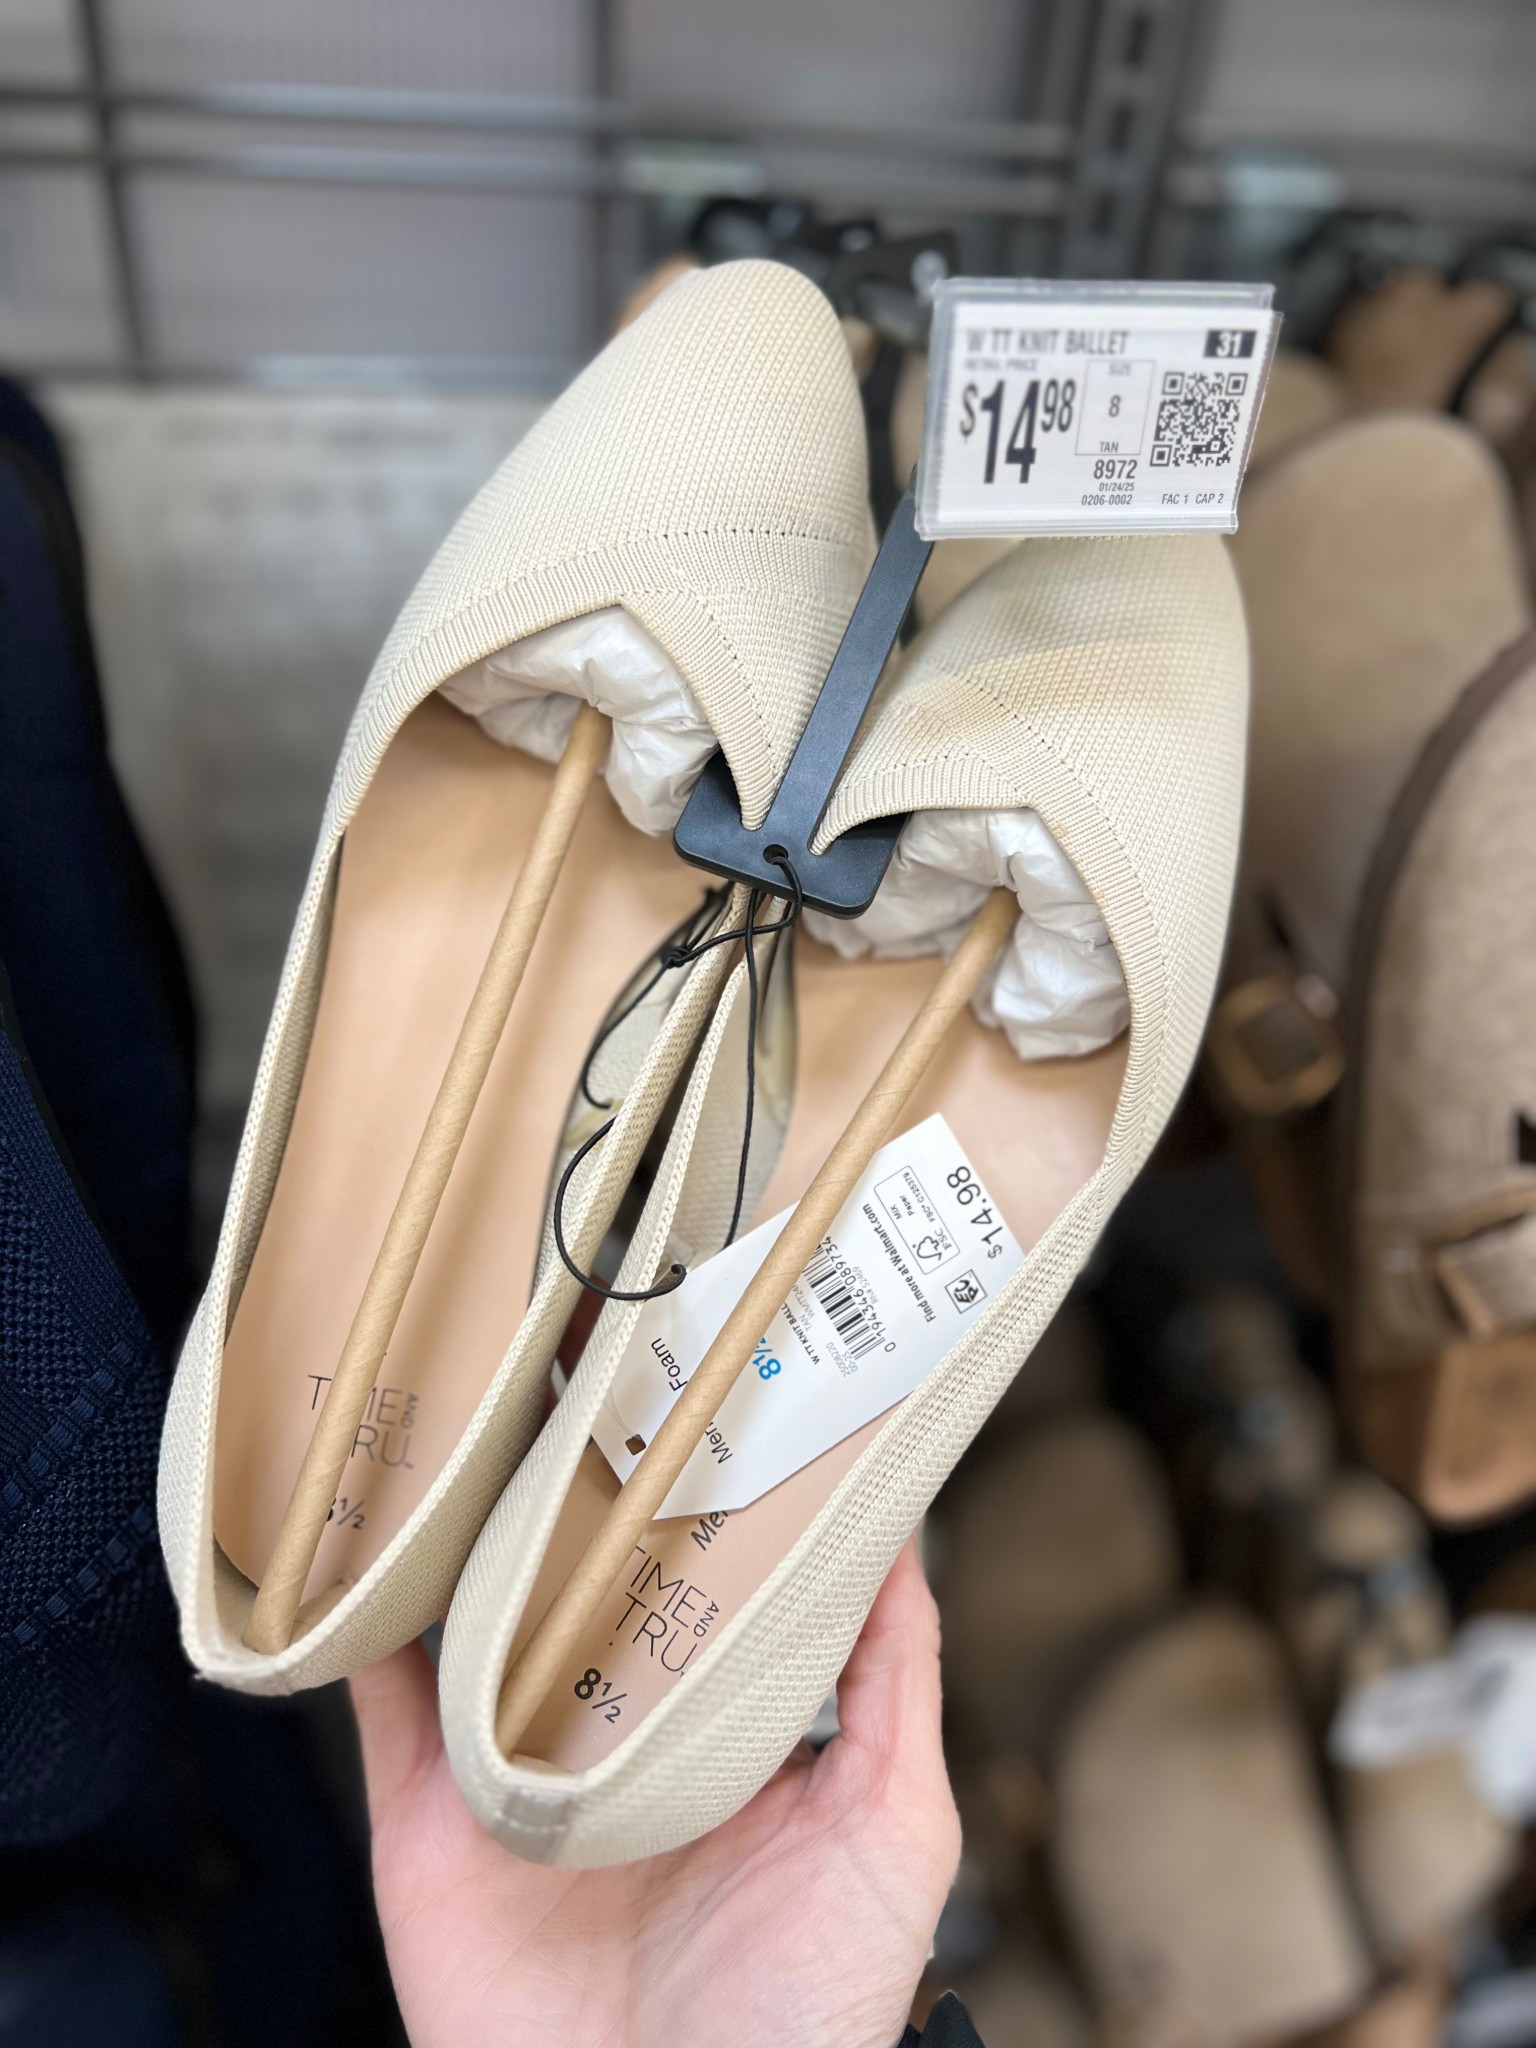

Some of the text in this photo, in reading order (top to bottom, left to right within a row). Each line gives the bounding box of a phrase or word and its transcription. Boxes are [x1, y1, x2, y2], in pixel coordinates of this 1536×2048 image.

[966, 330, 1130, 354] W TT KNIT BALLET
[1215, 332, 1243, 356] 31
[1108, 363, 1132, 376] SIZE
[1108, 395, 1121, 417] 8
[1099, 442, 1119, 453] TAN
[1094, 460, 1137, 480] 8972
[1099, 482, 1135, 492] 01/24/25
[1081, 494, 1133, 506] 0206-0002
[1162, 494, 1180, 505] FAC
[1195, 494, 1215, 505] CAP
[889, 1204, 902, 1219] MIX
[899, 1195, 914, 1216] Paper
[947, 1166, 1003, 1259] $14.98
[862, 1203, 901, 1266] Walmart.com
[934, 1227, 952, 1251] FSC
[793, 1285, 815, 1318] WMTT24
[822, 1236, 897, 1352] 0 194346 089734
[904, 1273, 926, 1307] more
[917, 1297, 936, 1323] Find
[781, 1303, 821, 1365] W TT KNIT BALL
[651, 1337, 688, 1391] Foam
[693, 1600, 719, 1637] AND
